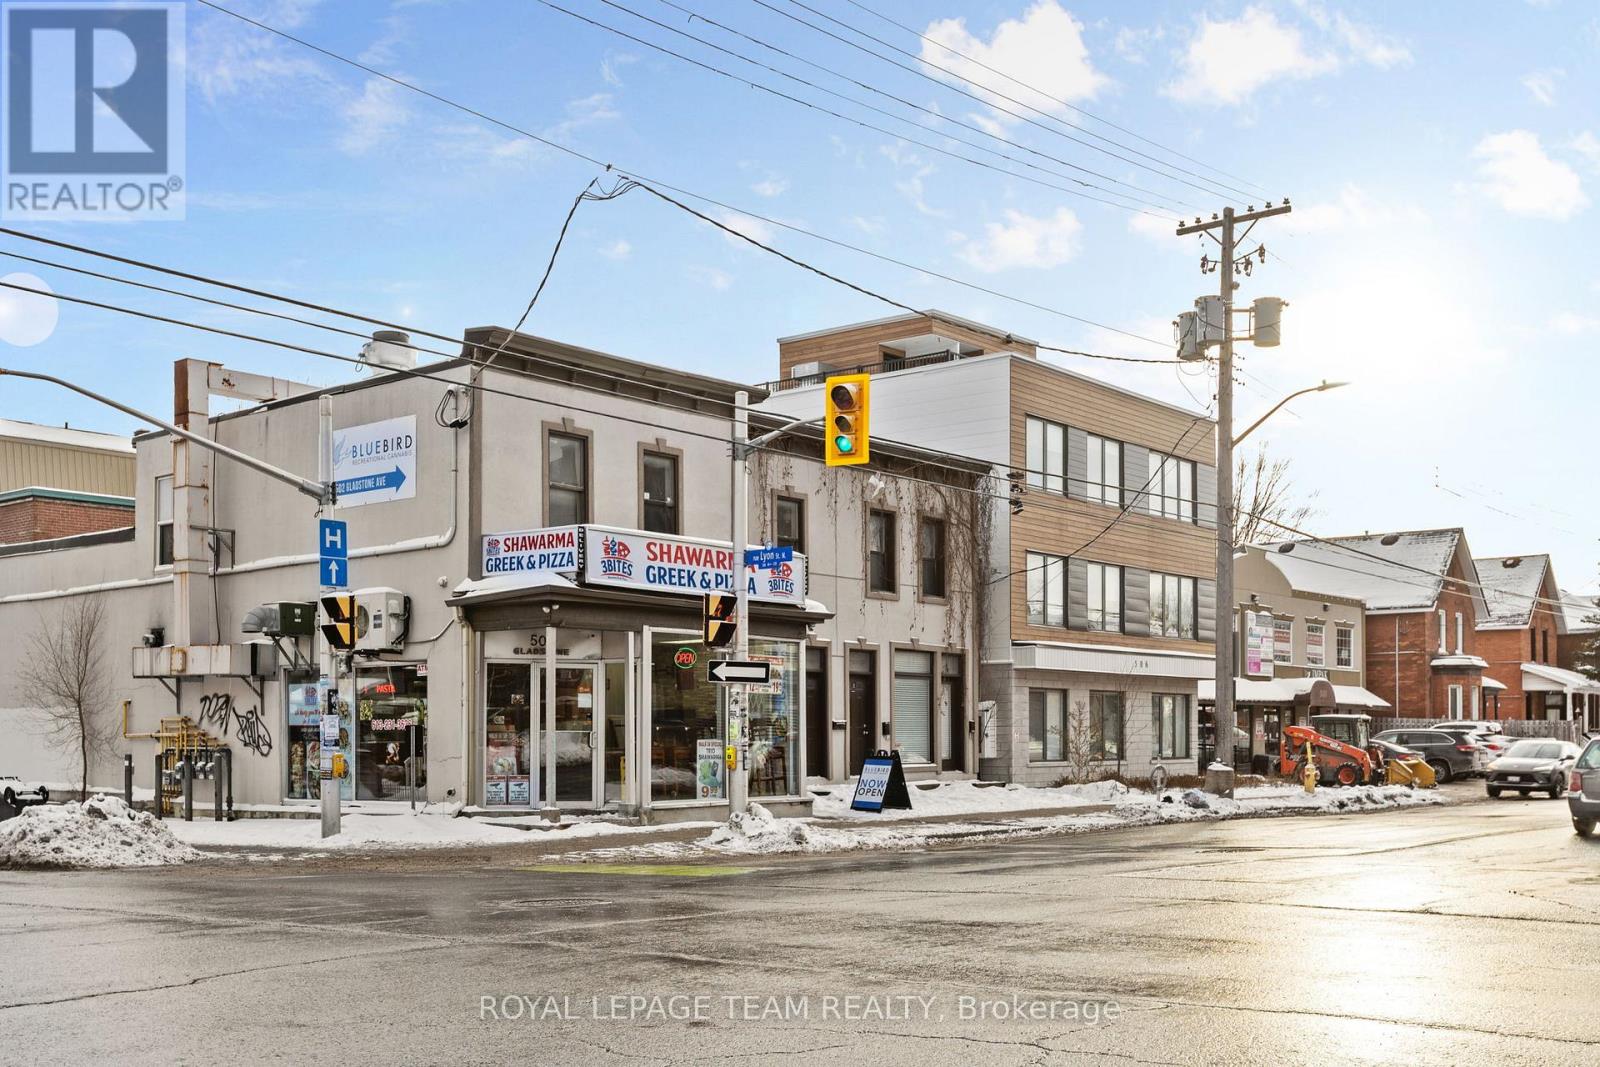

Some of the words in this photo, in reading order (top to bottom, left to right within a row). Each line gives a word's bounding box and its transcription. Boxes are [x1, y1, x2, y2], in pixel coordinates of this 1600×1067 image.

[351, 434, 413, 459] BLUEBIRD
[346, 476, 375, 492] GLADSTONE
[375, 475, 386, 487] AVE
[325, 527, 342, 549] H
[503, 531, 575, 553] SHAWARMA
[485, 555, 524, 573] GREEK
[526, 554, 536, 570] &
[538, 551, 575, 569] PIZZA
[760, 550, 775, 563] Lyon
[600, 558, 633, 576] 3BITES
[645, 564, 697, 588] GREEK
[699, 571, 711, 589] &
[714, 572, 757, 595] PIA
[768, 578, 795, 594] 3BITES
[530, 634, 546, 647] 50
[676, 652, 695, 664] OPEN
[376, 684, 396, 693] PASTA
[860, 778, 886, 789] NOW
[857, 787, 885, 797] OPEN
